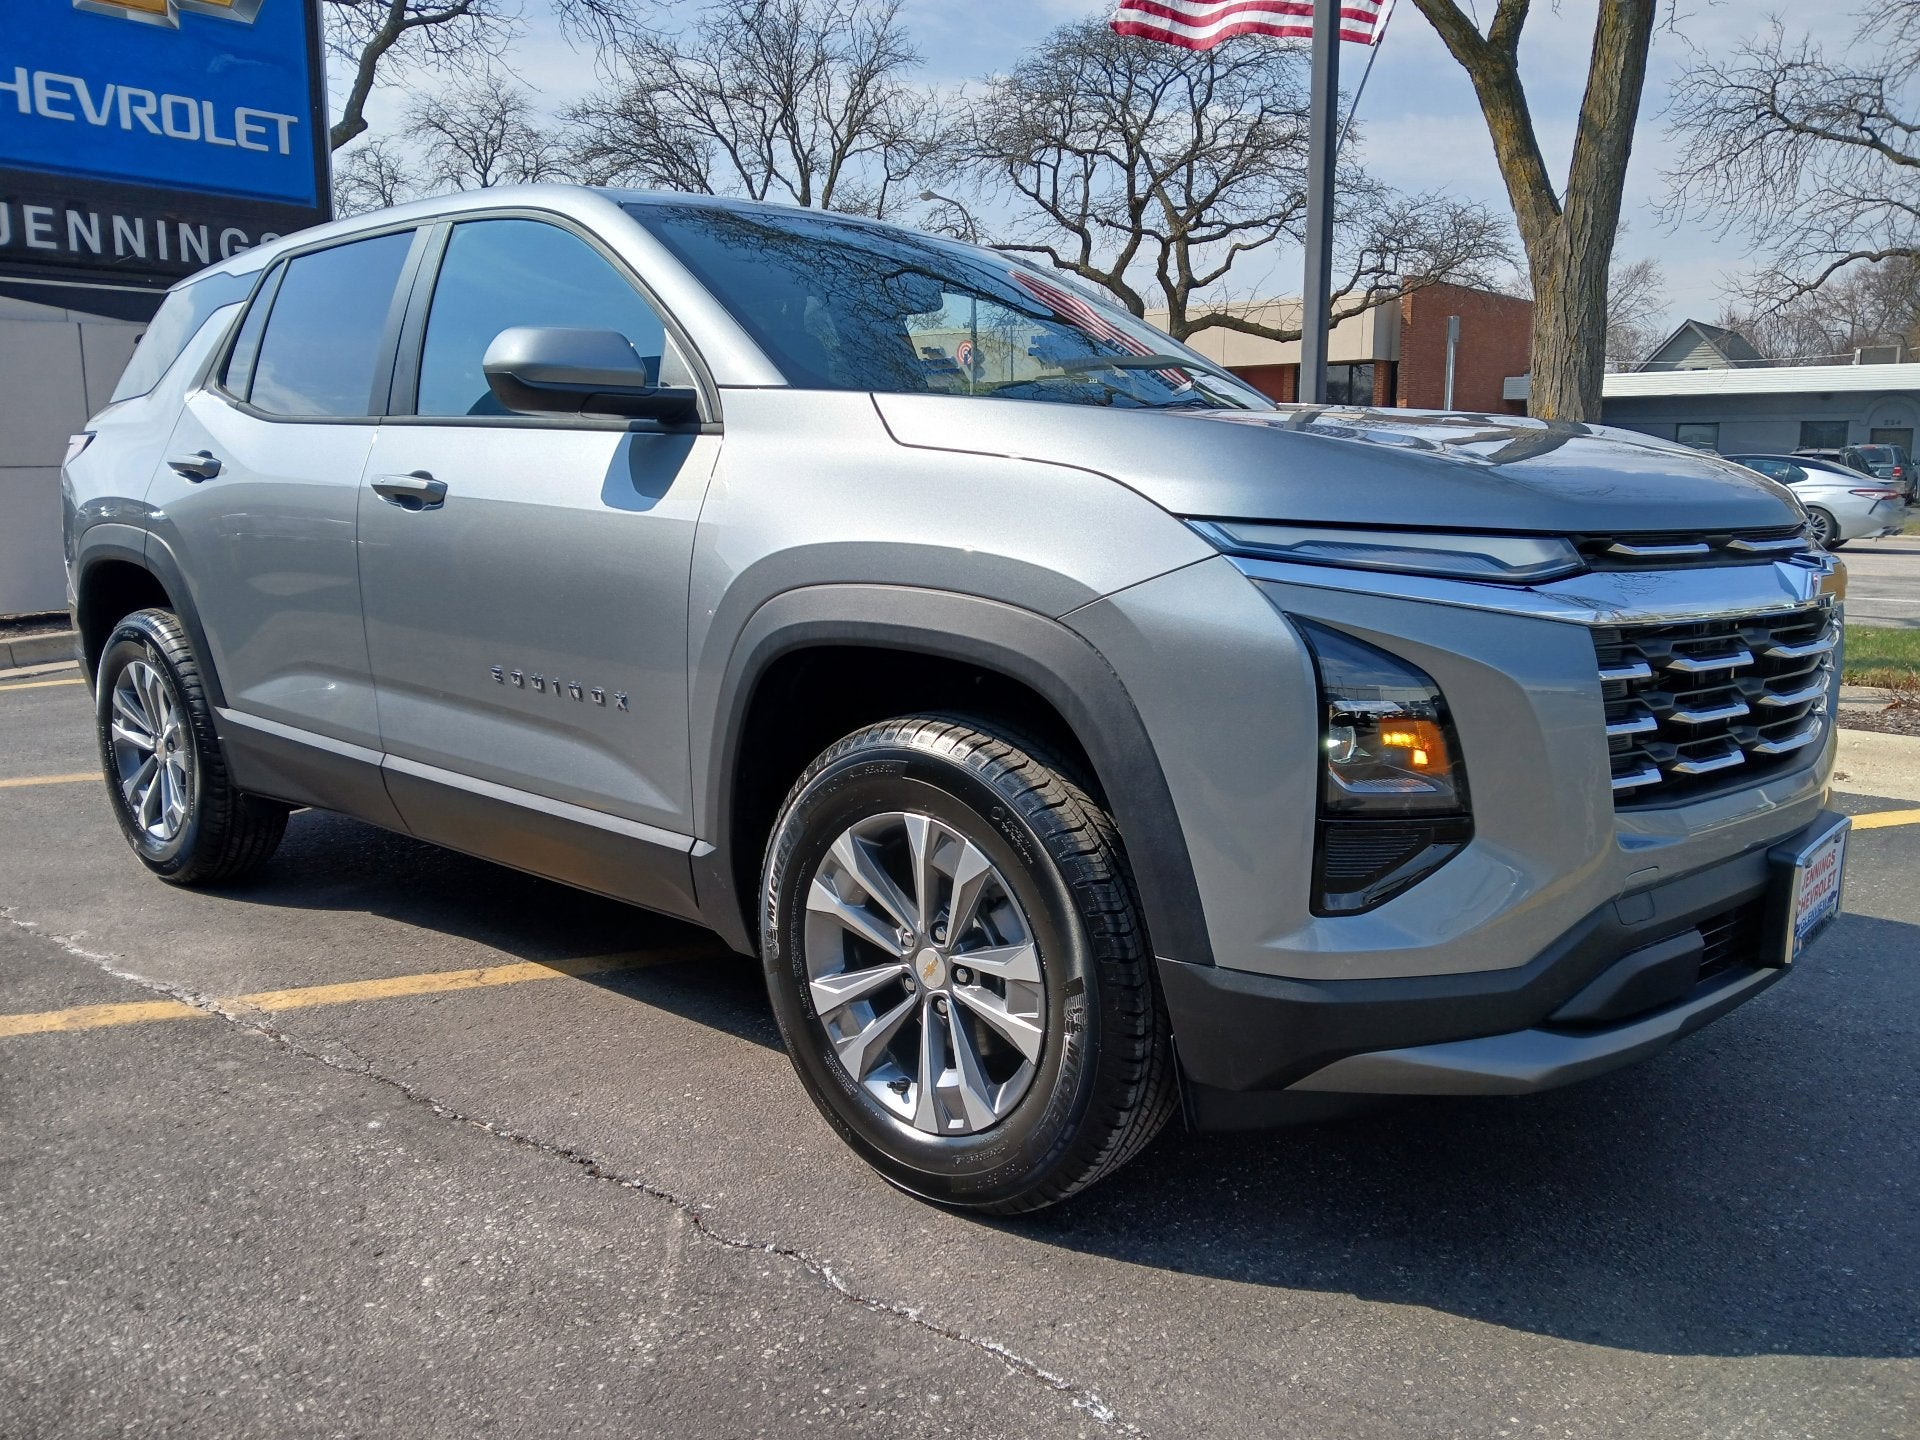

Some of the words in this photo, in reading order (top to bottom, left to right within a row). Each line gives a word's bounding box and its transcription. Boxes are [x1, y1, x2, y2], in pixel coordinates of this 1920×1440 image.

[0, 66, 298, 155] HEVROLET
[0, 203, 284, 264] JENNING
[491, 664, 629, 712] EQUINOX
[1801, 850, 1836, 892] JENNINGS
